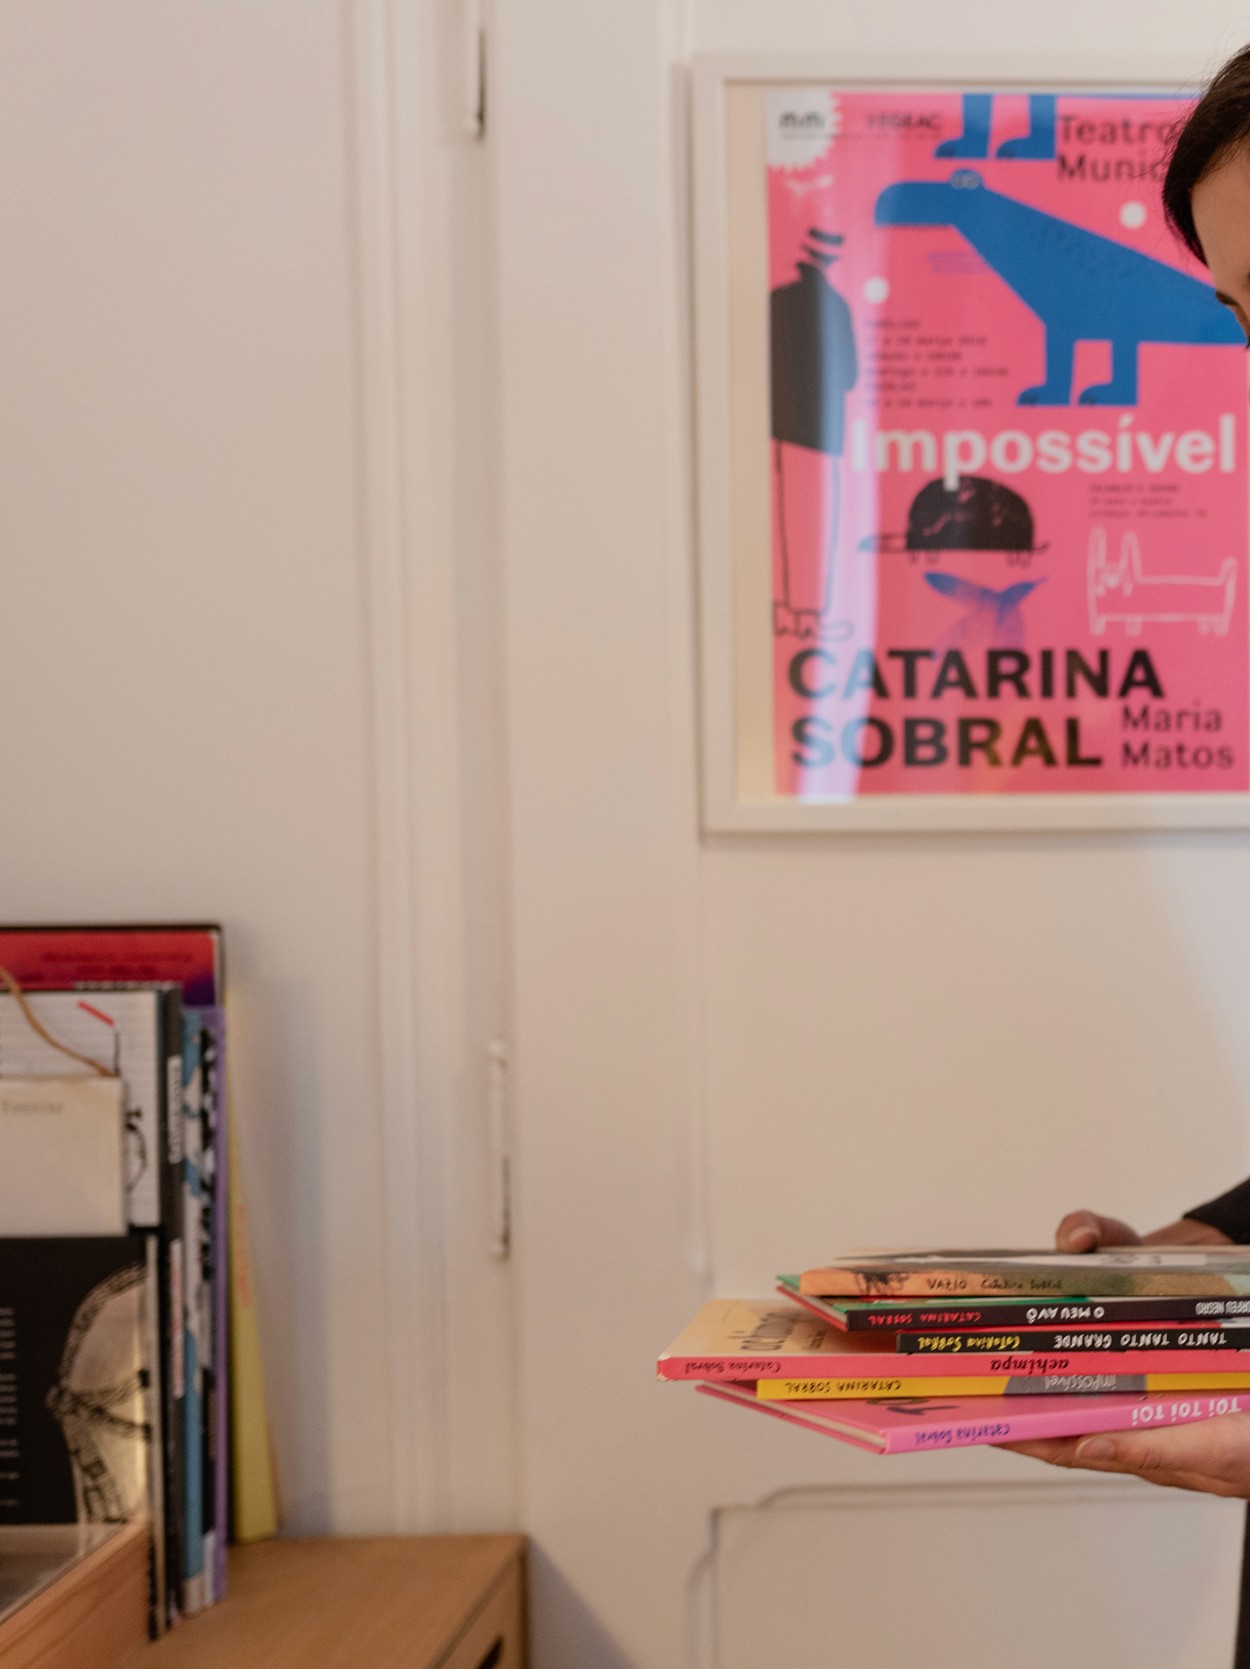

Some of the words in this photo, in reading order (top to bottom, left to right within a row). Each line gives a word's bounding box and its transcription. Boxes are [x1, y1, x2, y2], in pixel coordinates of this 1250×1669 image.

[1057, 149, 1167, 182] Munic
[851, 414, 1236, 492] Impossível
[787, 648, 1164, 699] CATARINA
[1121, 700, 1224, 733] Maria
[791, 716, 1104, 769] SOBRAL
[1121, 741, 1236, 770] Matos
[1060, 1307, 1091, 1319] MEU
[1094, 1306, 1105, 1318] O
[1195, 1302, 1225, 1315] NEGRO
[867, 1313, 913, 1325] SOBRAL
[919, 1311, 981, 1323] CATARINA
[1026, 1308, 1059, 1324] AVÔ
[1054, 1334, 1112, 1349] GRANDE
[1121, 1333, 1170, 1347] TANTO
[1178, 1333, 1227, 1345] TANTO
[727, 1361, 782, 1373] Catarina
[989, 1357, 1070, 1375] achimpa
[783, 1381, 832, 1394] SOBRAL
[835, 1379, 902, 1391] CATARINA
